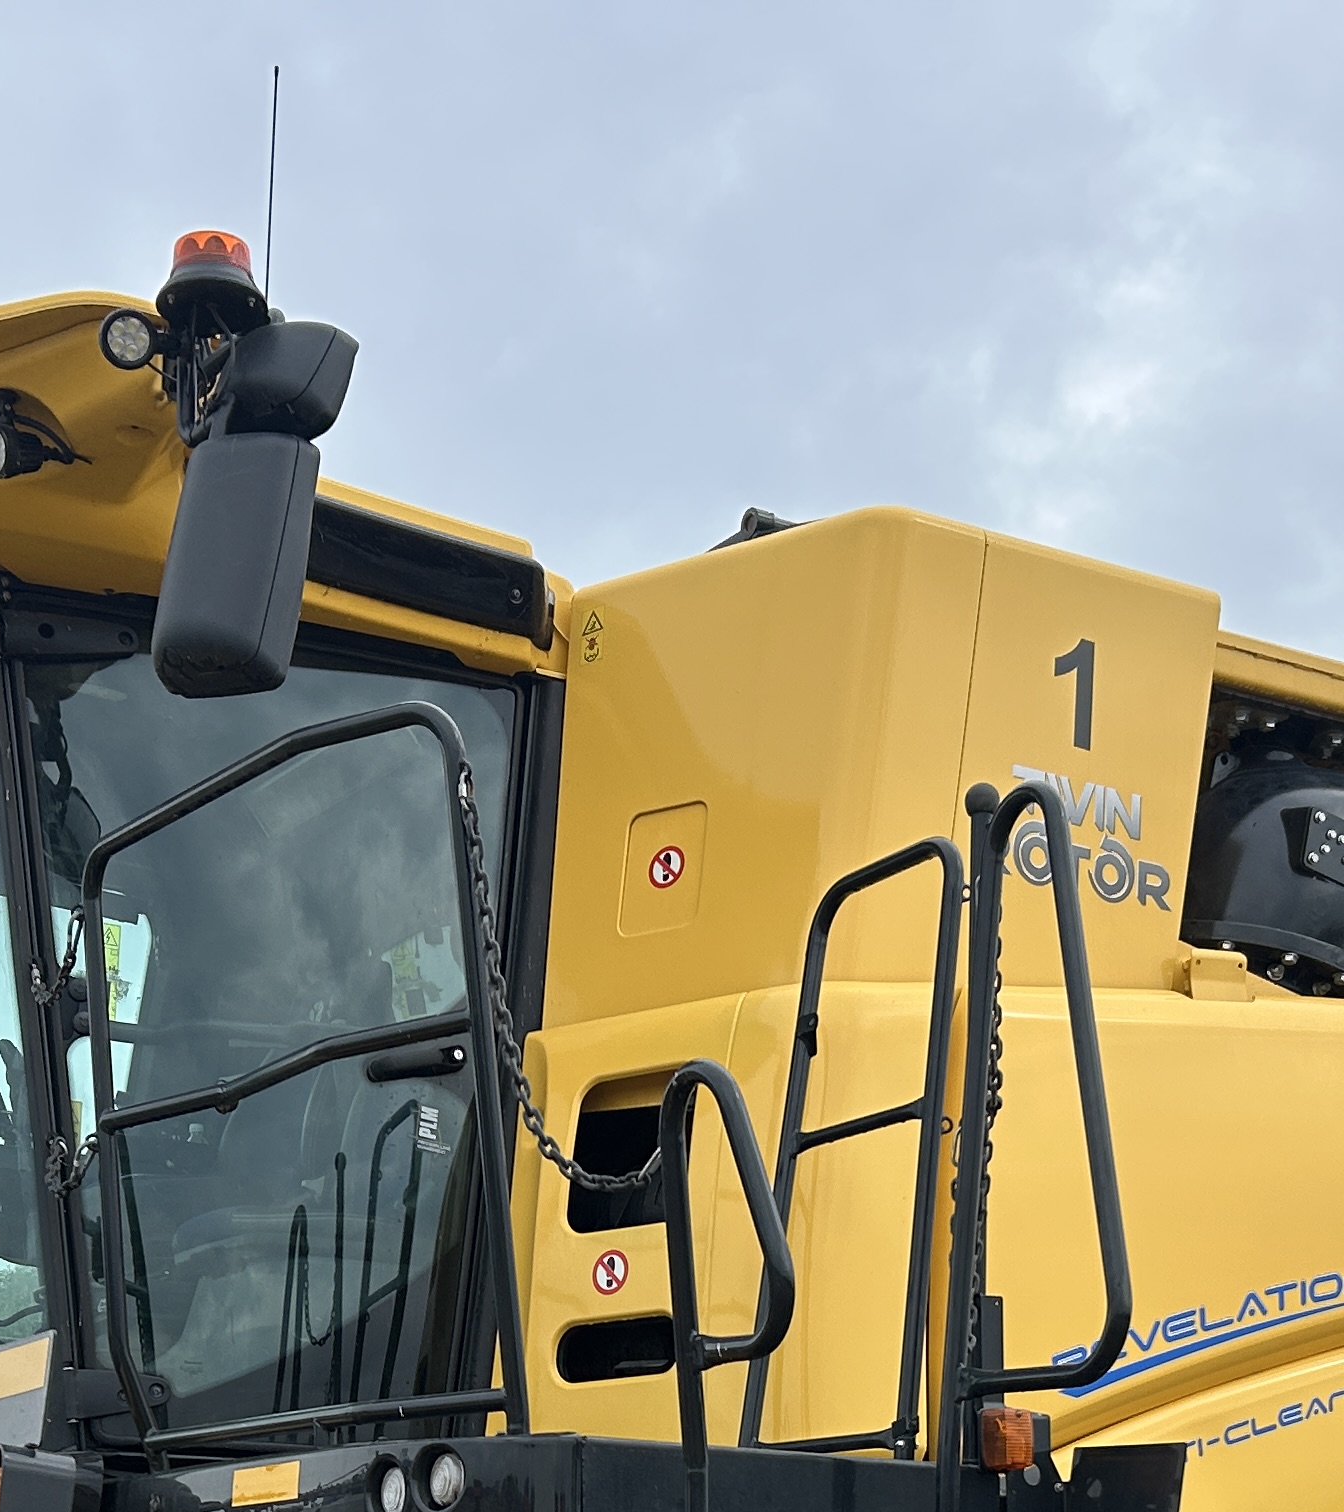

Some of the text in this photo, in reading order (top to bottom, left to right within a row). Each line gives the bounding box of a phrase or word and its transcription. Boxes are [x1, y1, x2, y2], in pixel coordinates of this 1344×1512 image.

[1054, 638, 1096, 751] 1
[1012, 764, 1142, 841] TWIN
[1002, 832, 1172, 912] OTOR
[418, 1105, 440, 1140] PLM
